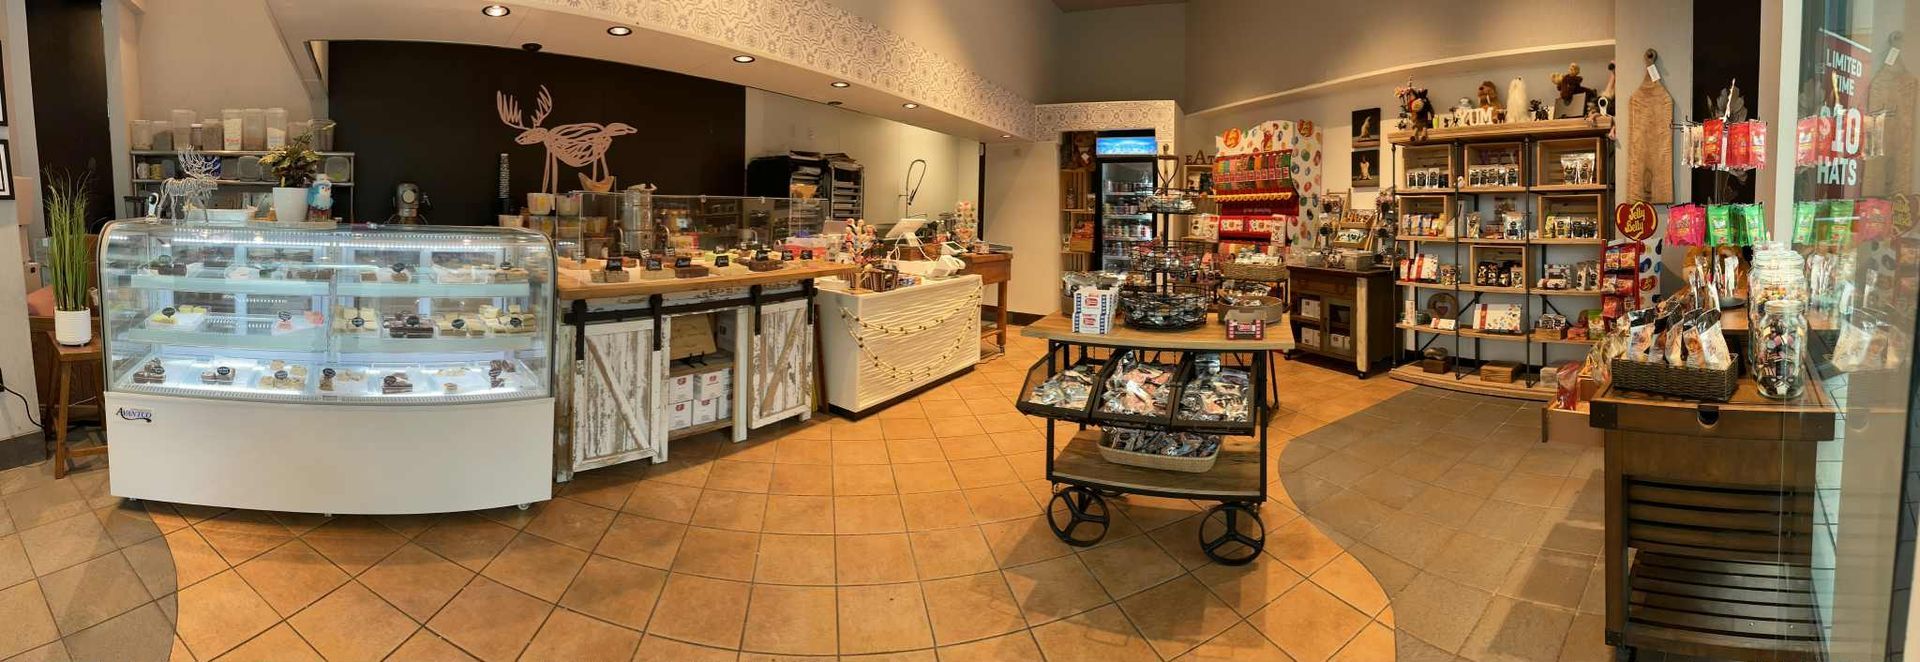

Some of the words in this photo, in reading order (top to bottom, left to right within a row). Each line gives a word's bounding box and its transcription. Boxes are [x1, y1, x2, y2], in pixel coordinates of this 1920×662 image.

[1825, 48, 1862, 78] LIMITED
[1835, 74, 1855, 96] TIME
[1185, 149, 1216, 165] EAT
[1816, 156, 1857, 186] HATS
[1628, 207, 1646, 221] Jelly
[1624, 220, 1645, 234] Belly
